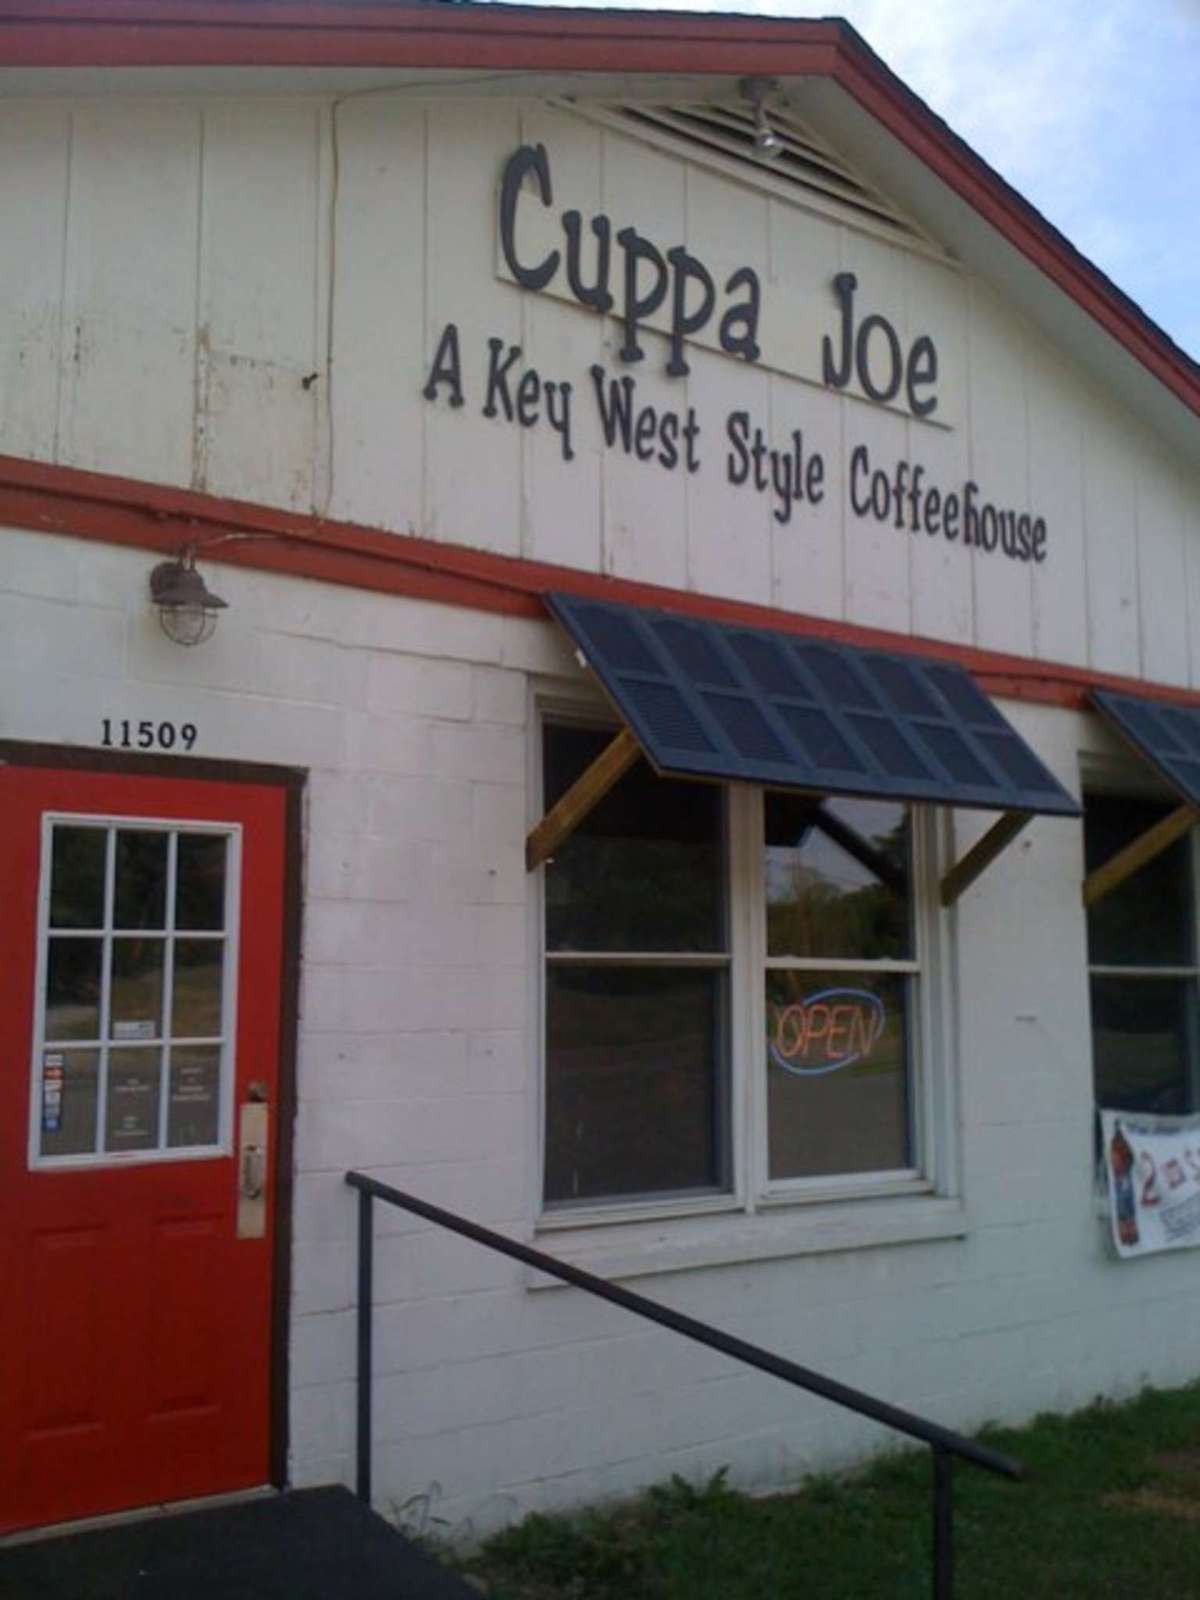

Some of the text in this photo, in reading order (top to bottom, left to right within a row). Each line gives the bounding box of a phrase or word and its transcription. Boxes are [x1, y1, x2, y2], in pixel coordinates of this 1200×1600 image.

[499, 142, 939, 415] Cuppa Joe
[423, 323, 1048, 563] A Key West Style Coffeehouse
[101, 717, 198, 752] 11509
[776, 1003, 877, 1059] OPEN
